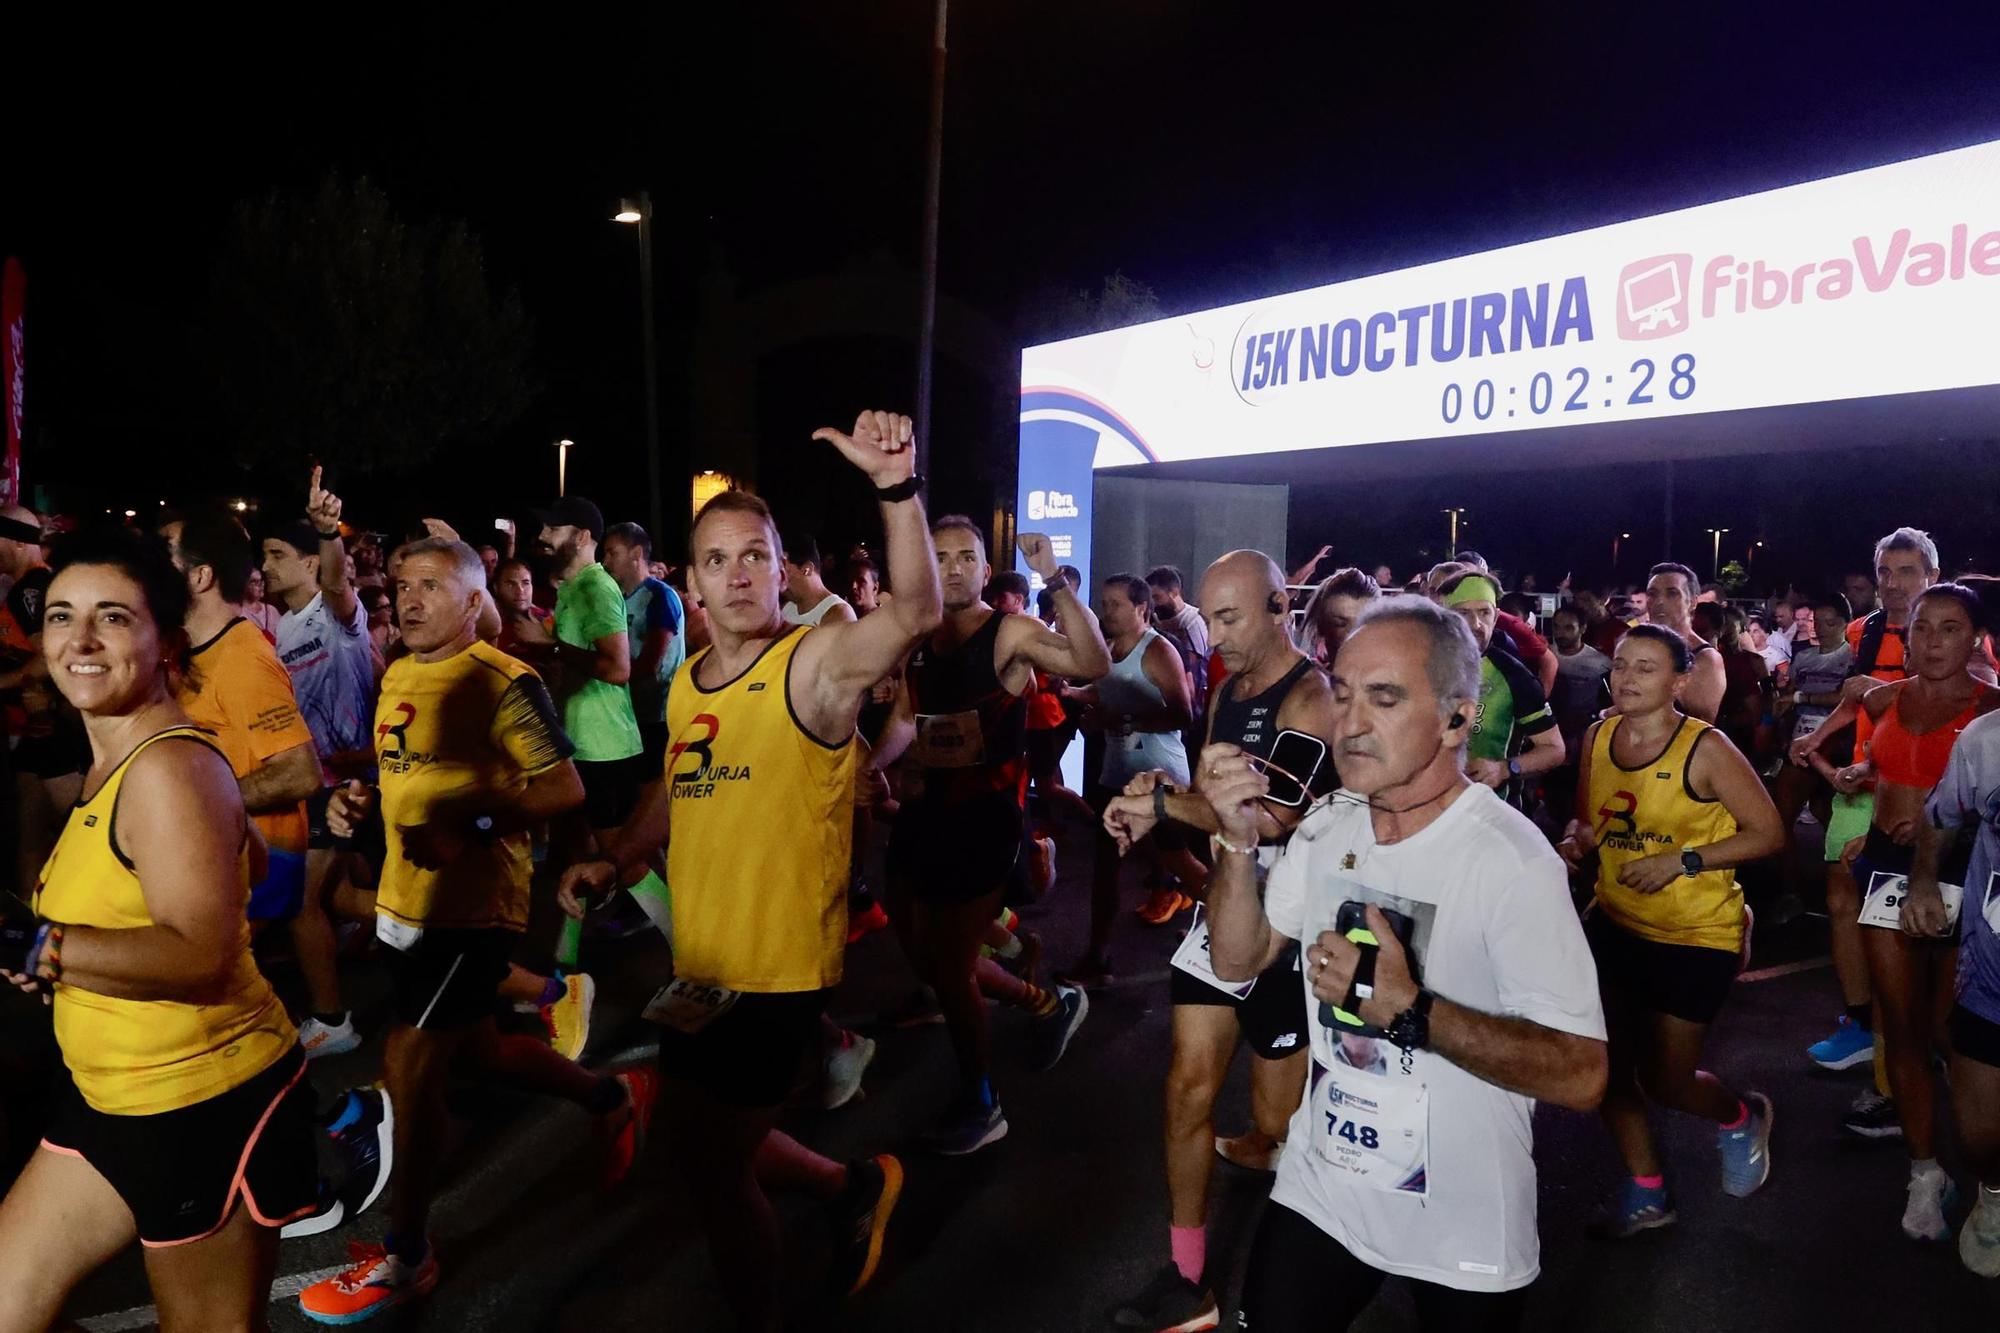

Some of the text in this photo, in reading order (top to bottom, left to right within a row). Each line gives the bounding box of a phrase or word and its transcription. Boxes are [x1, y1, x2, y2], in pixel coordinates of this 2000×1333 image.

[1241, 328, 1296, 391] 15K
[1299, 276, 1594, 382] NOCTURNA
[1442, 353, 1696, 424] 00:02:28
[1325, 1110, 1379, 1149] 748
